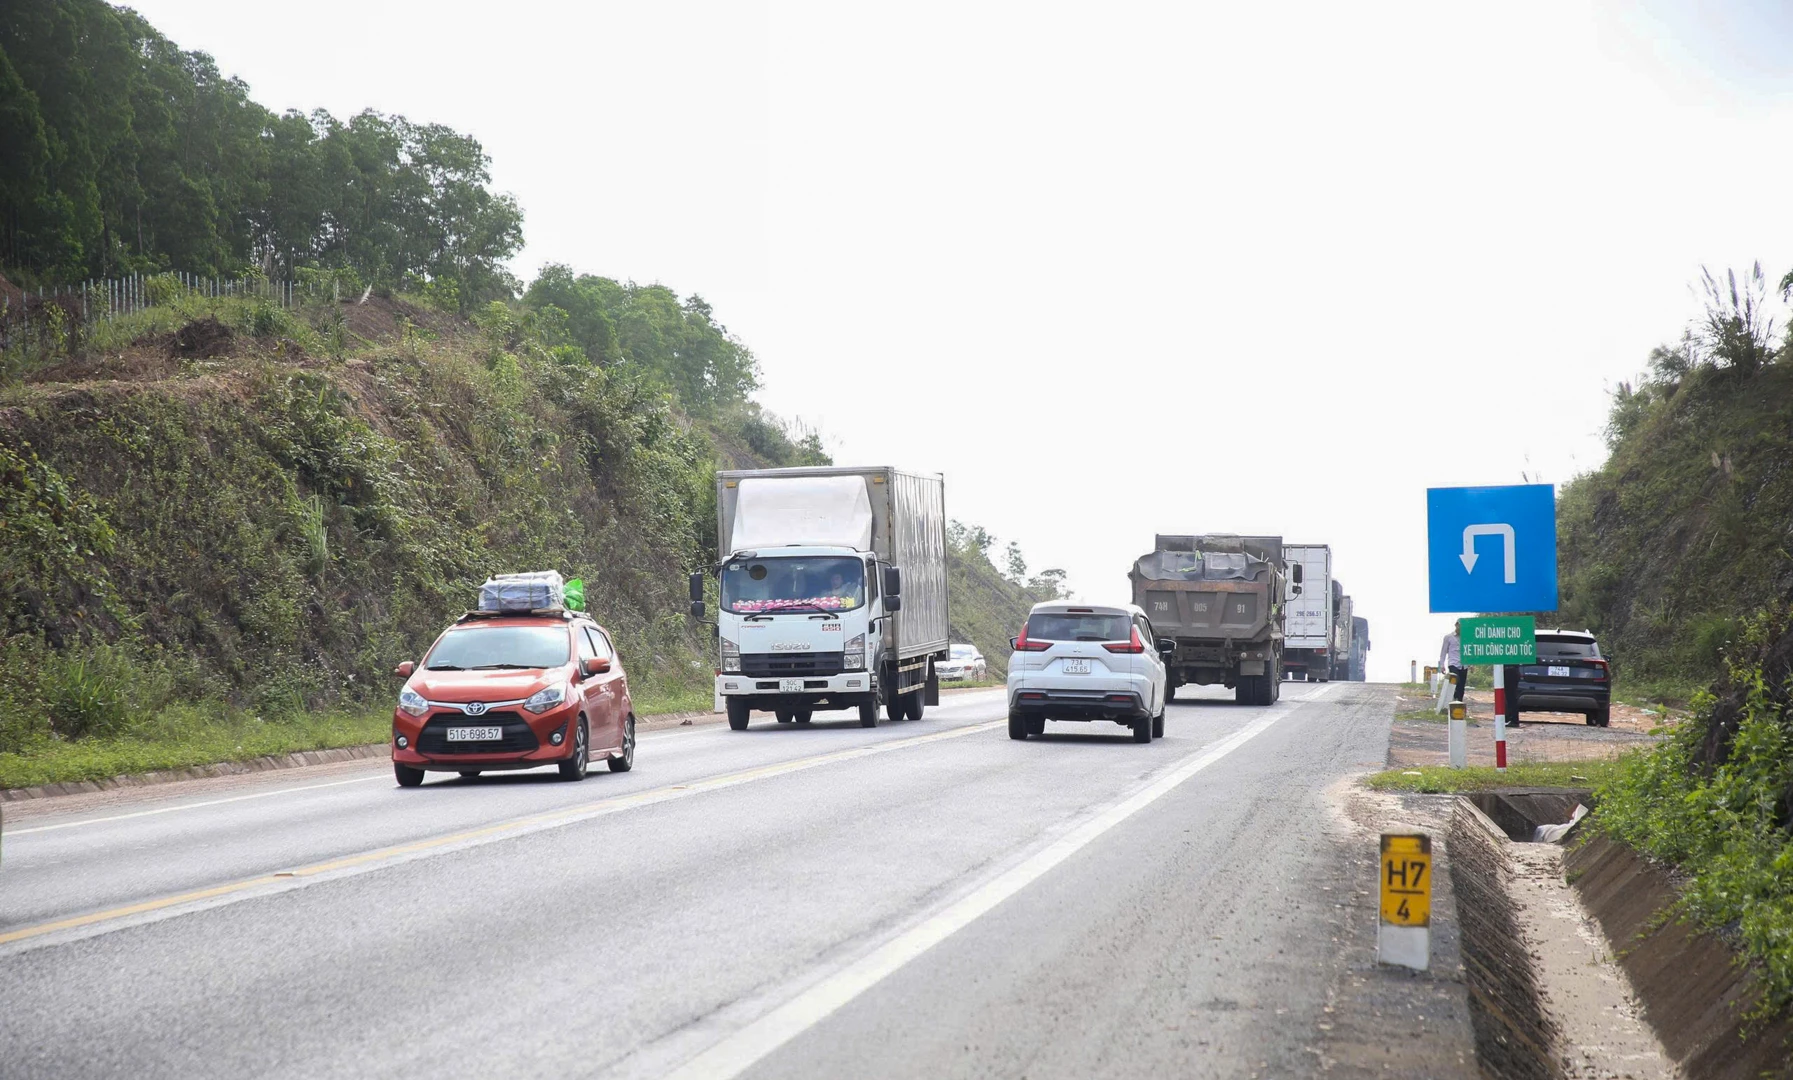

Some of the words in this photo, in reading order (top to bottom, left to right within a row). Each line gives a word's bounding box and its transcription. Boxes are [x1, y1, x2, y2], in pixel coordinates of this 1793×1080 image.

[1237, 604, 1245, 613] 91
[1475, 623, 1486, 639] CHỈ
[1487, 624, 1505, 639] DÀNH
[1507, 627, 1521, 639] CHO
[771, 642, 811, 651] ISUZU
[1463, 644, 1472, 656] XE
[1473, 644, 1484, 656] THI
[1485, 642, 1503, 656] CÔNG
[1505, 644, 1518, 656] CAO
[1519, 640, 1533, 656] TỐC
[449, 728, 500, 740] 51G-698.57
[1386, 860, 1426, 887] H7
[1397, 899, 1411, 921] 4
